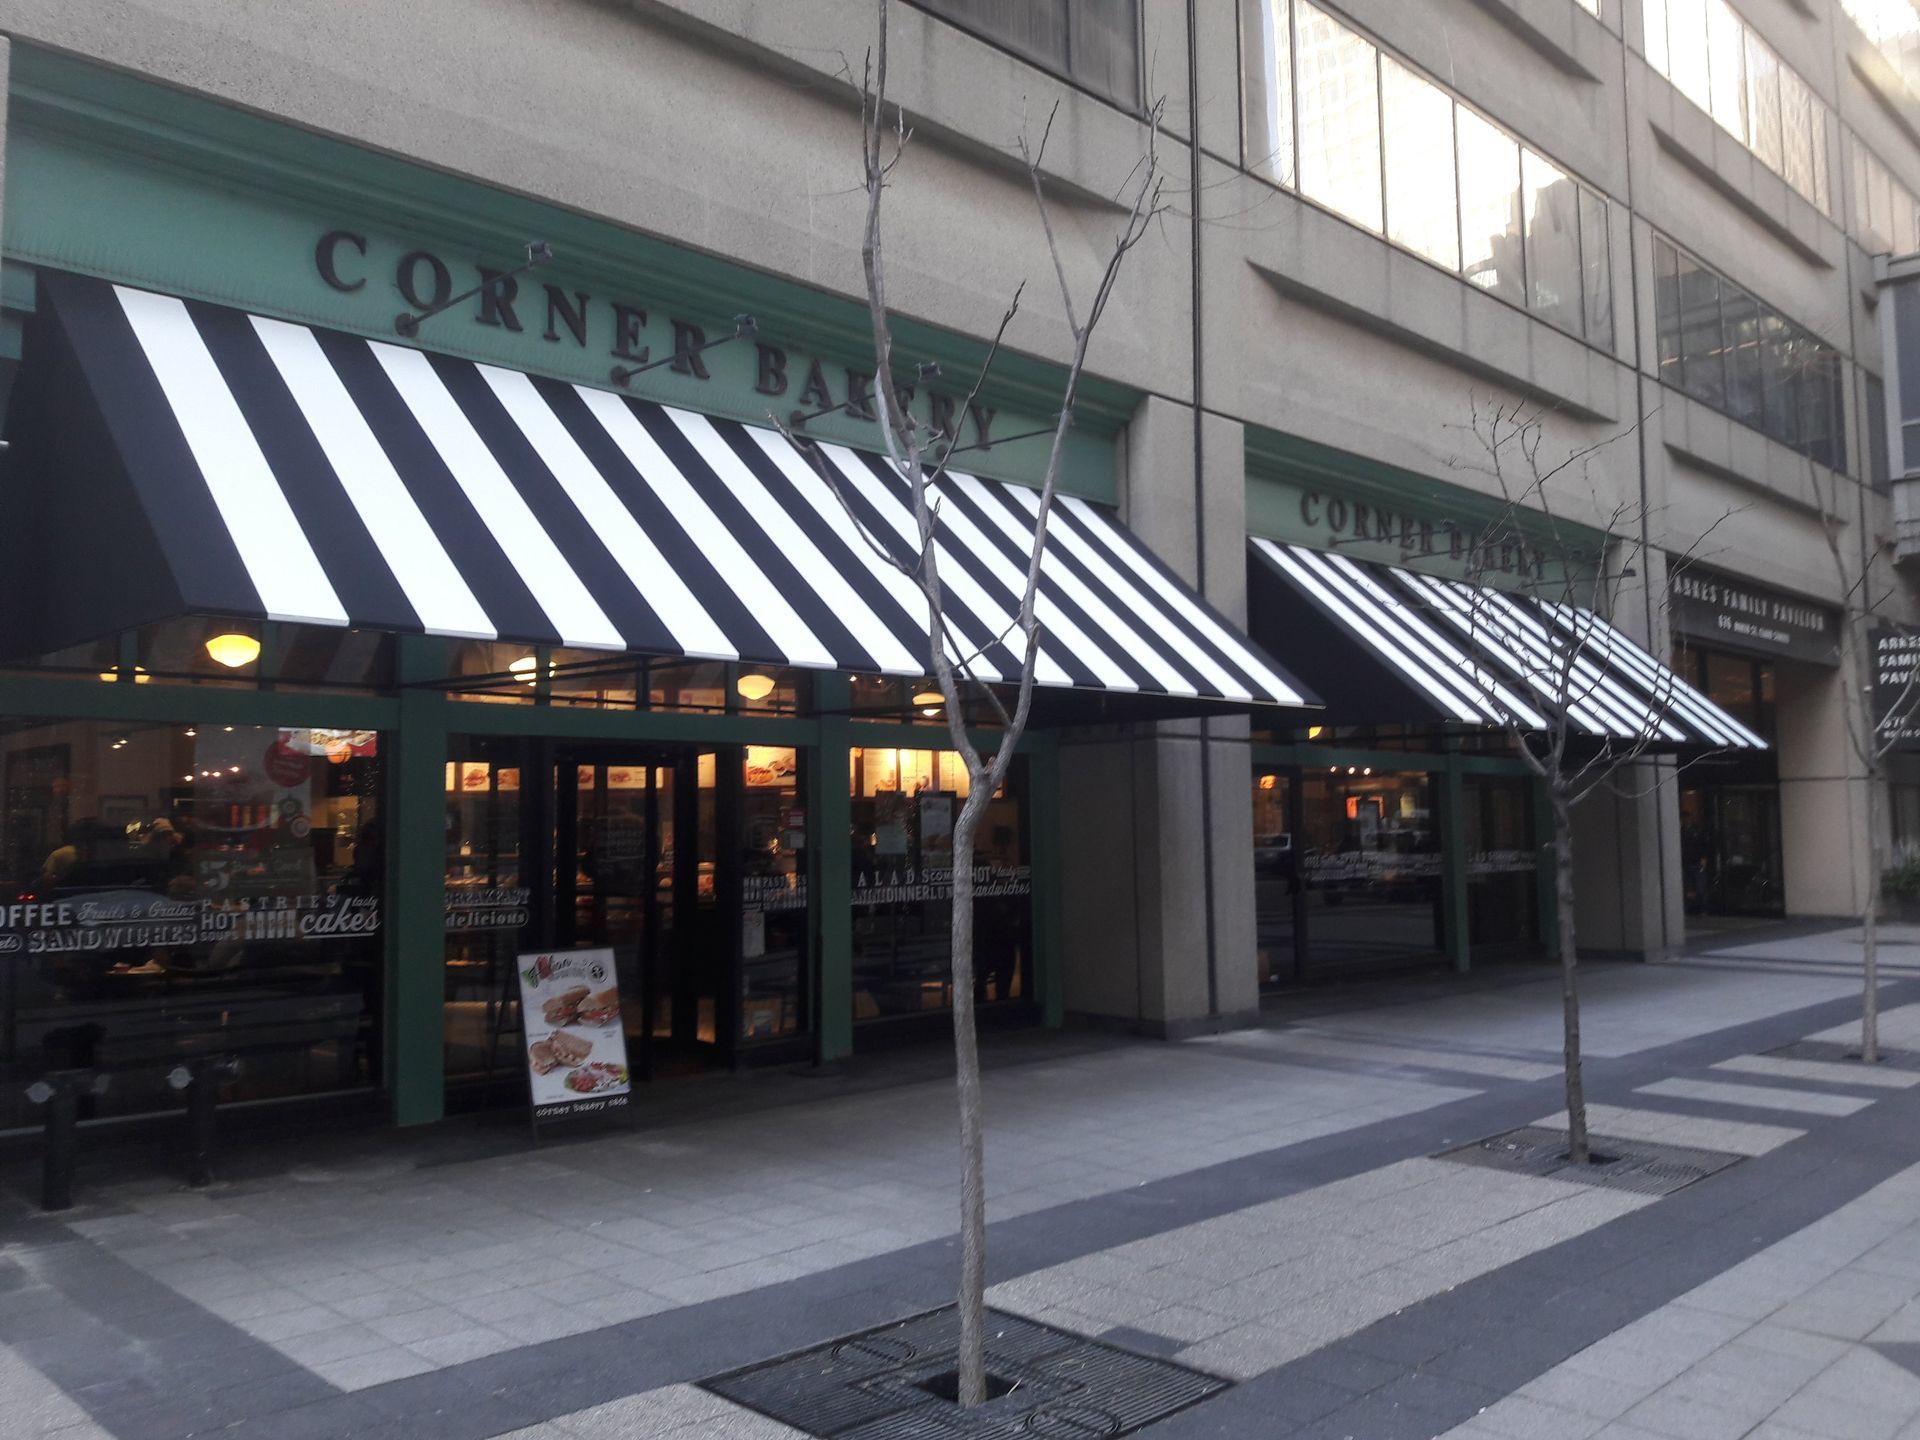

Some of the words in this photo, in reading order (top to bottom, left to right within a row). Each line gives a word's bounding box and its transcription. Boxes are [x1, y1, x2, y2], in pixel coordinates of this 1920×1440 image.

[314, 228, 711, 384] CORNER
[1299, 492, 1434, 554] CORNER
[1449, 526, 1546, 581] BKERY
[1723, 589, 1767, 617] FAMILY
[1772, 602, 1825, 632] PAVILION
[1879, 670, 1920, 685] PAV
[857, 867, 930, 888] ALADS
[886, 884, 931, 904] DINNER
[931, 882, 953, 901] LUN
[971, 878, 1031, 898] andwiches
[147, 900, 196, 918] Grains
[200, 895, 338, 913] PASTRIES
[201, 911, 241, 931] HOT
[299, 896, 381, 935] cakes
[445, 910, 526, 928] delicious
